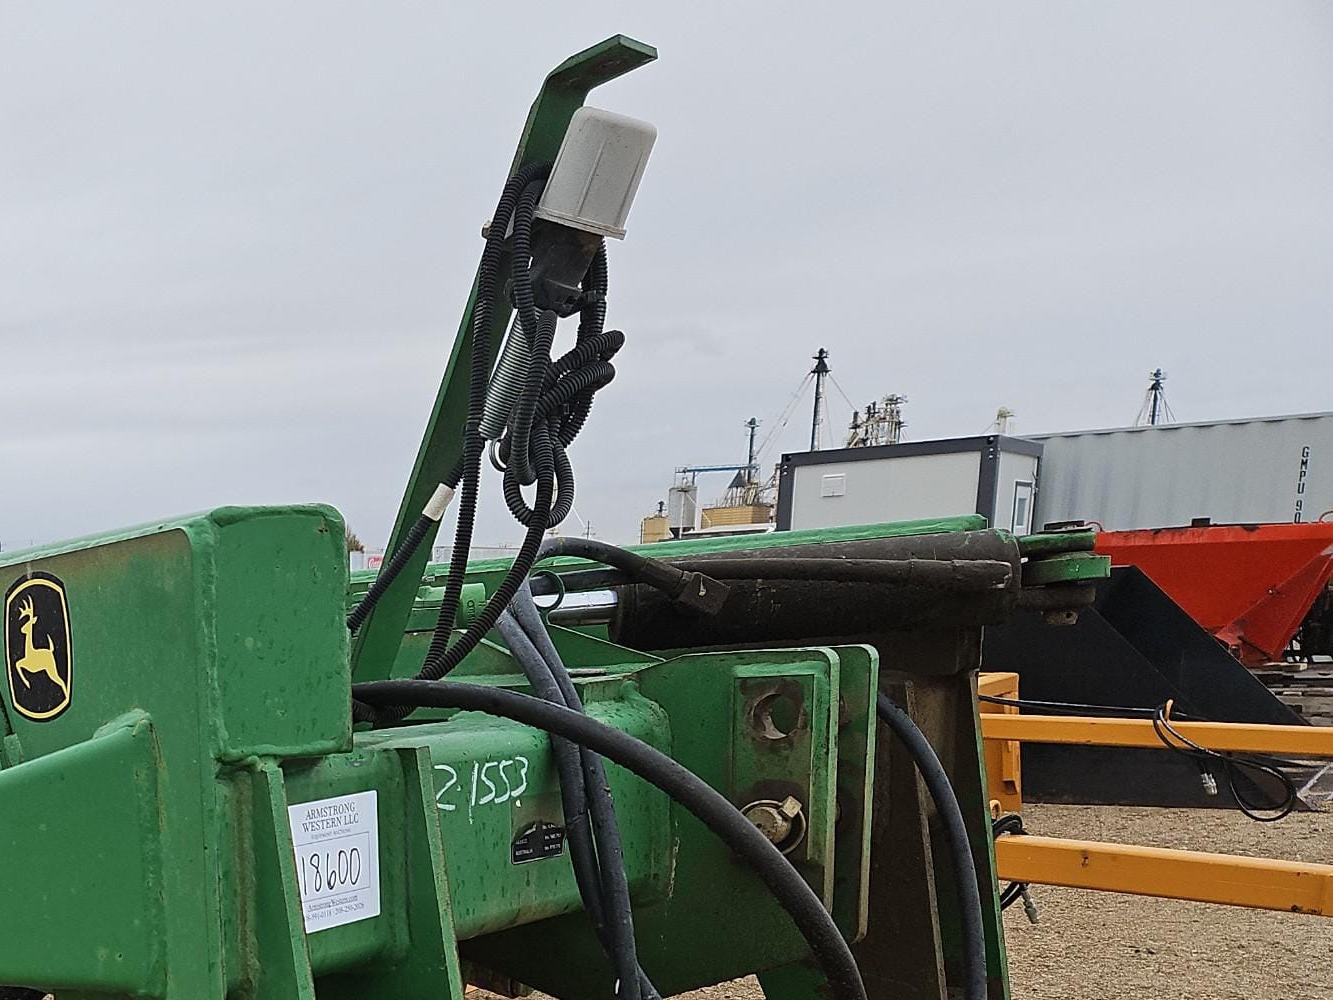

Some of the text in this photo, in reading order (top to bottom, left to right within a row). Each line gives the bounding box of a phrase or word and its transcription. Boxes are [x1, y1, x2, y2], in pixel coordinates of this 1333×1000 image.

[1297, 446, 1310, 494] GMPU
[301, 812, 359, 833] WESTERN LLC
[305, 801, 356, 821] ARMSTRONG
[301, 847, 361, 896] 18600
